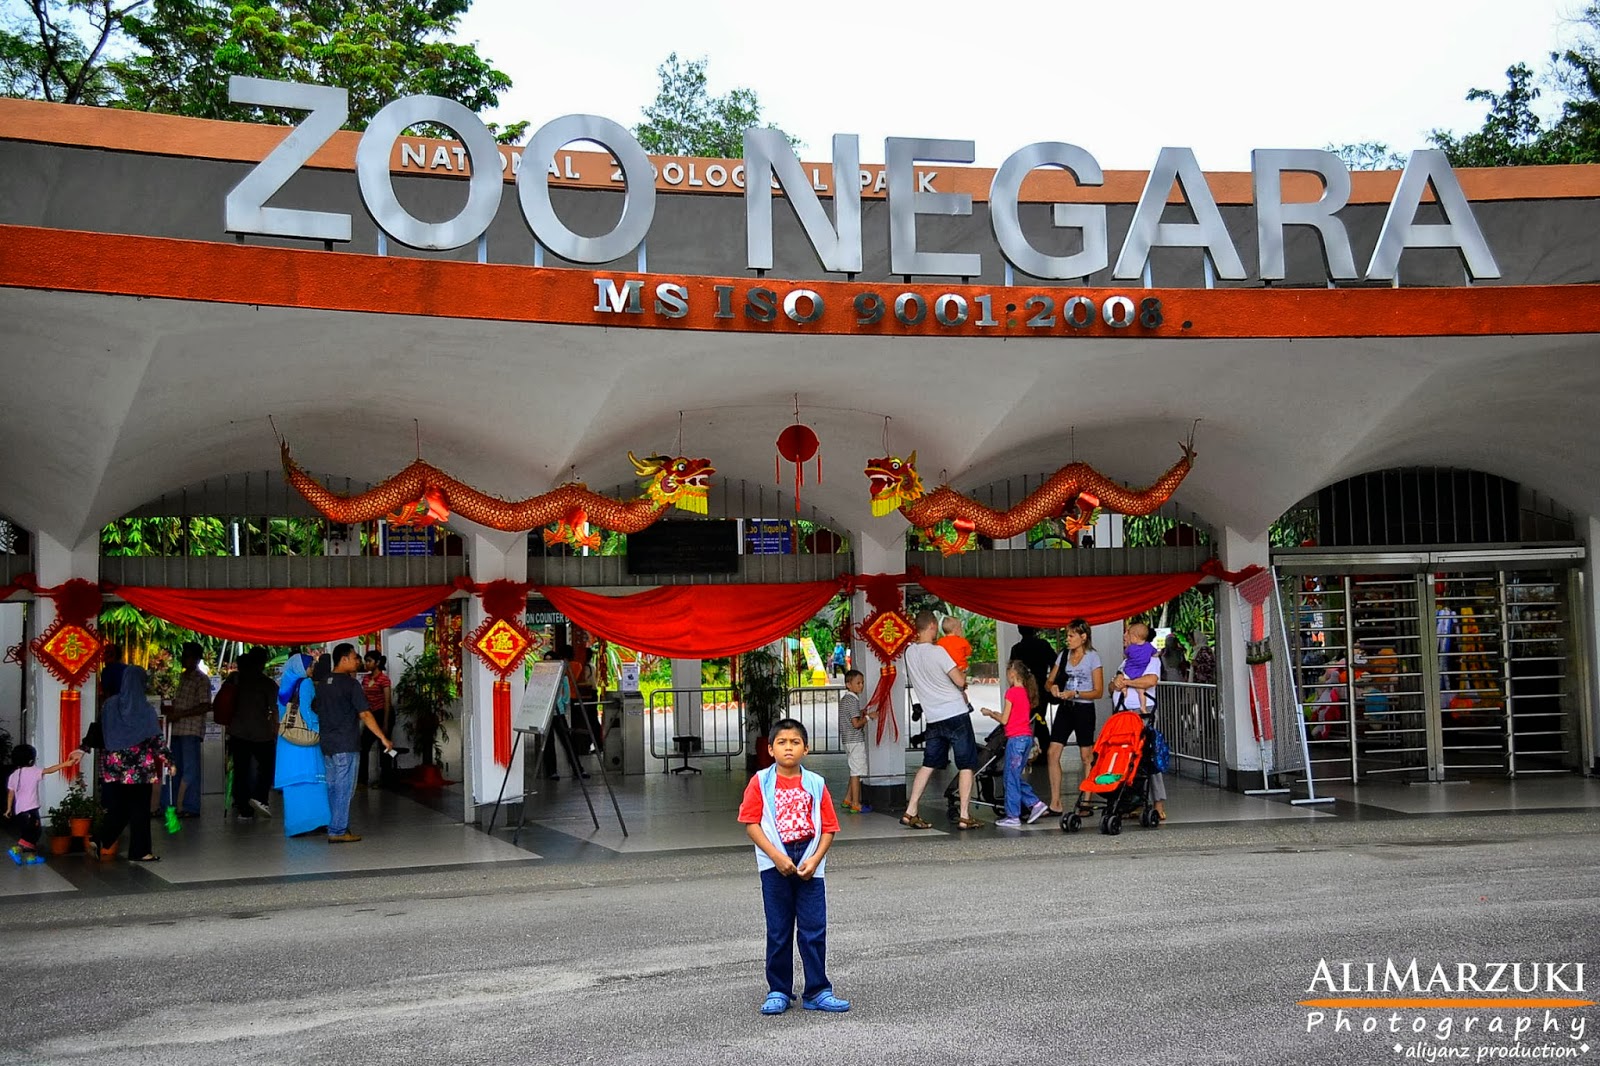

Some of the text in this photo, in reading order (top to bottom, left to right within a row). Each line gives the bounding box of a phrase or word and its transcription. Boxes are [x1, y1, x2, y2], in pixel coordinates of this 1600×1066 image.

[224, 75, 1501, 281] ZOO NEGARA
[860, 170, 938, 193] PAK
[593, 278, 689, 319] MS
[713, 285, 825, 323] ISO
[535, 612, 564, 624] COUNTER
[878, 619, 902, 643] 春
[59, 632, 88, 660] 春
